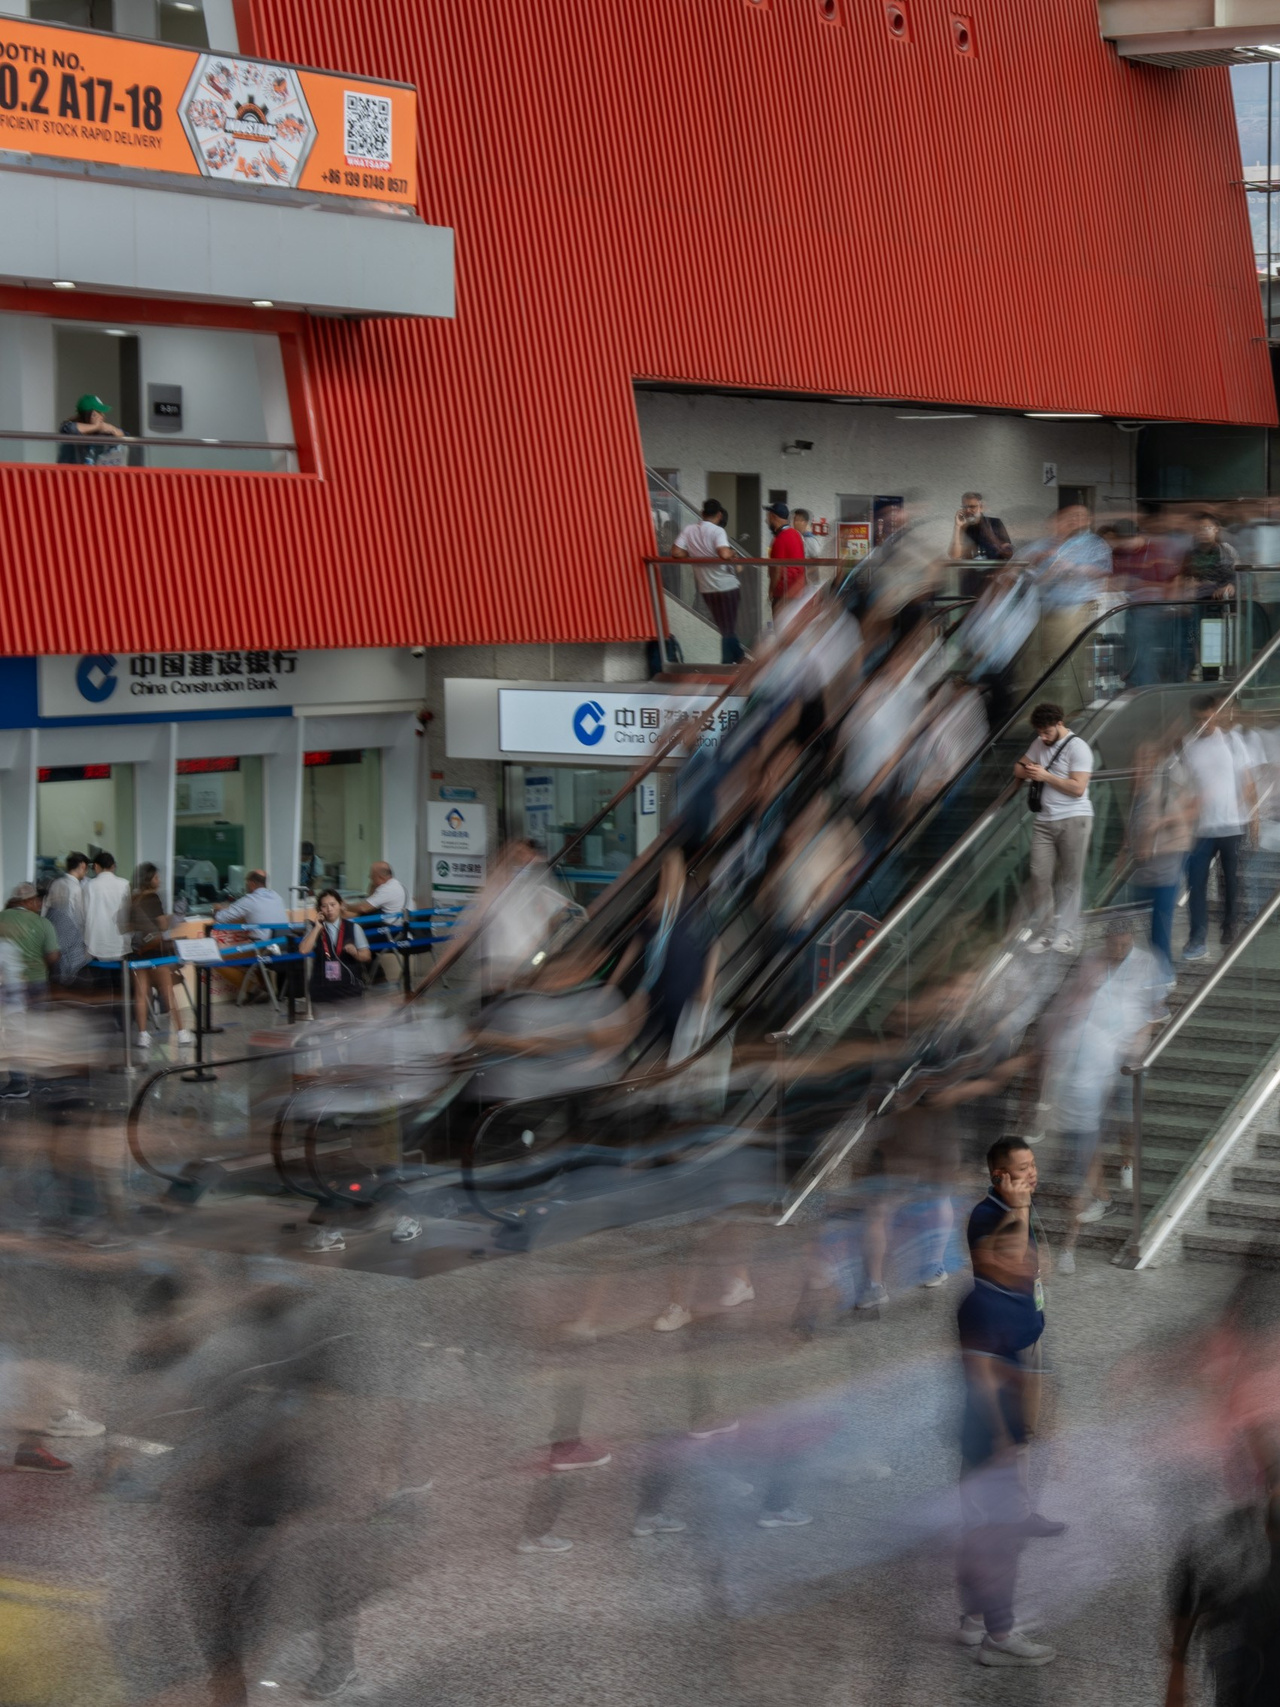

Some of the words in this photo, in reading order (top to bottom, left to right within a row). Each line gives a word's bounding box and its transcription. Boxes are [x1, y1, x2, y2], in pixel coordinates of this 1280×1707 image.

[52, 49, 85, 72] NO.
[58, 72, 163, 131] A17-18
[43, 120, 78, 138] STOCK
[81, 126, 112, 143] RAPID
[114, 130, 162, 149] DELIVERY
[346, 156, 391, 171] WHATSAPP
[321, 168, 341, 185] +86
[343, 171, 360, 188] 139
[362, 173, 385, 192] 6746
[388, 177, 408, 194] 0577
[130, 650, 298, 678] 中国建设银行
[130, 681, 168, 696] China
[171, 678, 245, 695] Construction
[247, 677, 279, 692] Bank
[614, 730, 645, 744] China
